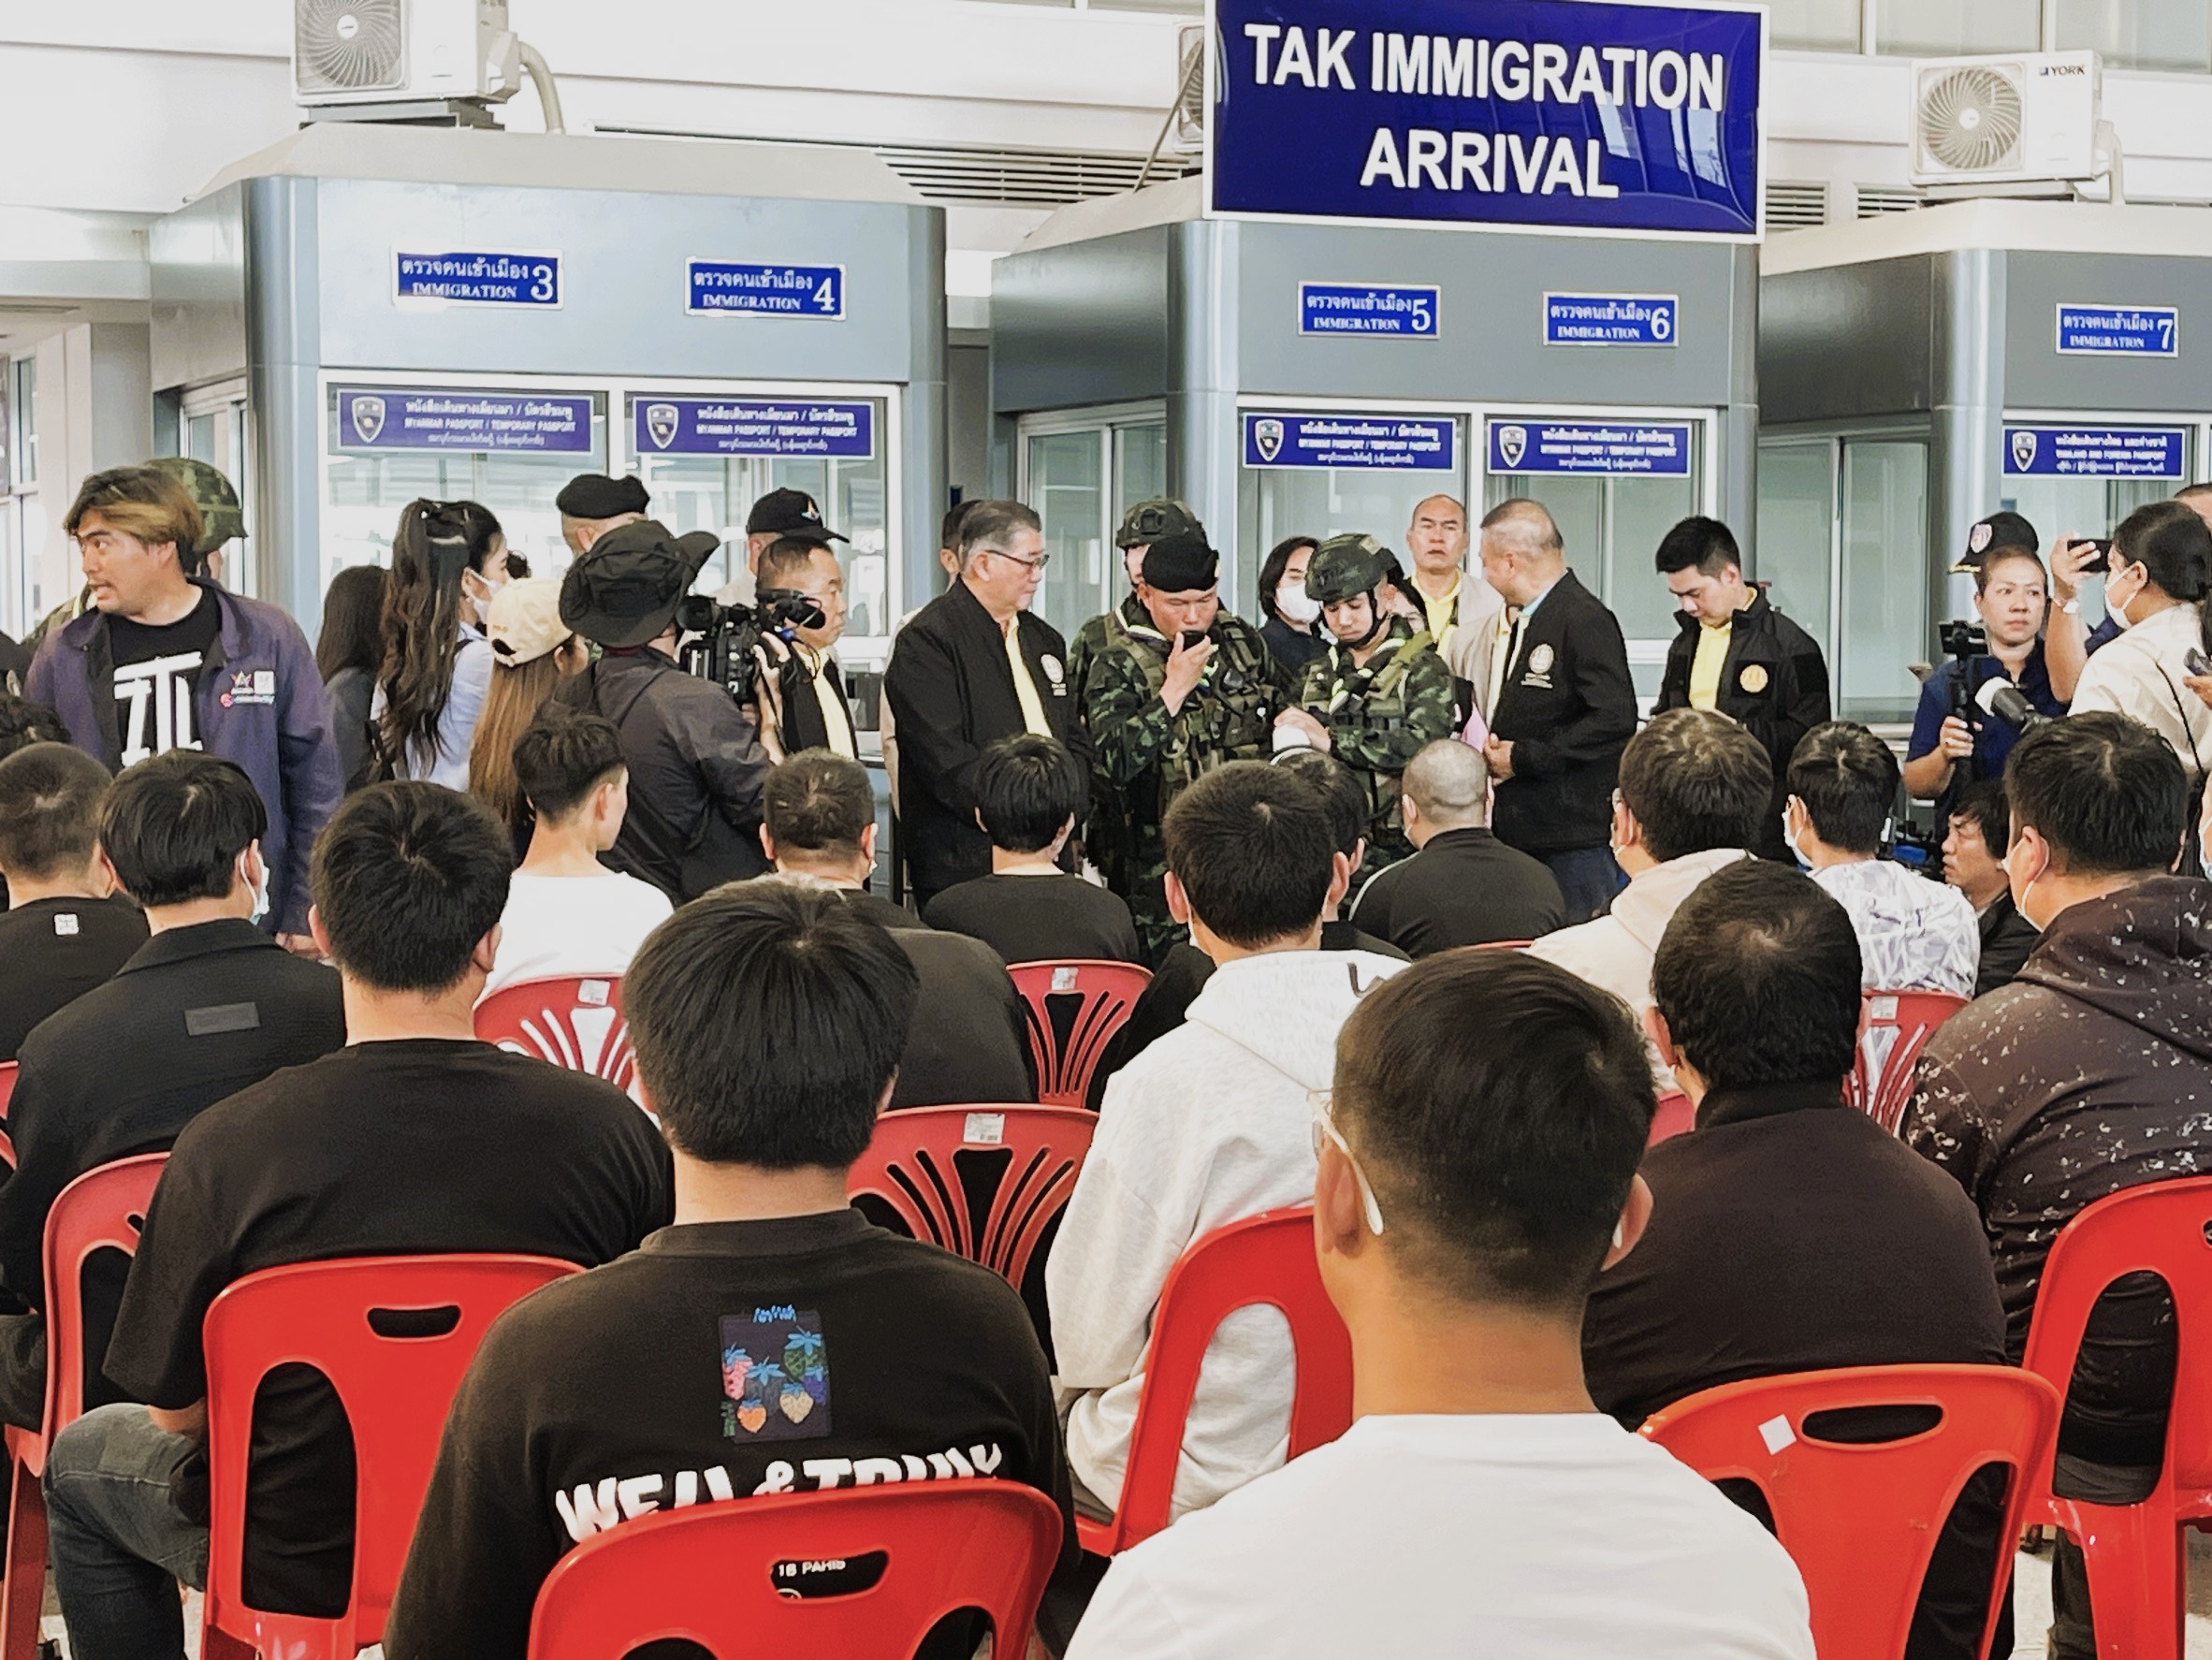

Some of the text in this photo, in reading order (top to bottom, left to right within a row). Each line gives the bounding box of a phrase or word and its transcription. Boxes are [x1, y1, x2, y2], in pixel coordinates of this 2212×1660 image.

[1244, 23, 1724, 111] TAK IMMIGRATION
[2051, 66, 2085, 76] YORK
[1360, 127, 1619, 198] ARRIVAL
[401, 256, 554, 301] ตรวจคนเข้าเมือง 3
[412, 282, 517, 299] IMMIGRATION
[694, 269, 836, 312] ตรวจคนเข้าเมือง 4
[703, 294, 802, 310] IMMIGRATION
[1307, 292, 1431, 331] ตรวจคนเข้าเมือง 5
[1314, 317, 1401, 330] IMMIGRATION
[1557, 326, 1639, 339] IMMIGRATION
[1651, 307, 1670, 340] 6
[2157, 318, 2173, 349] 7
[2070, 335, 2145, 348] IMMIGRATION
